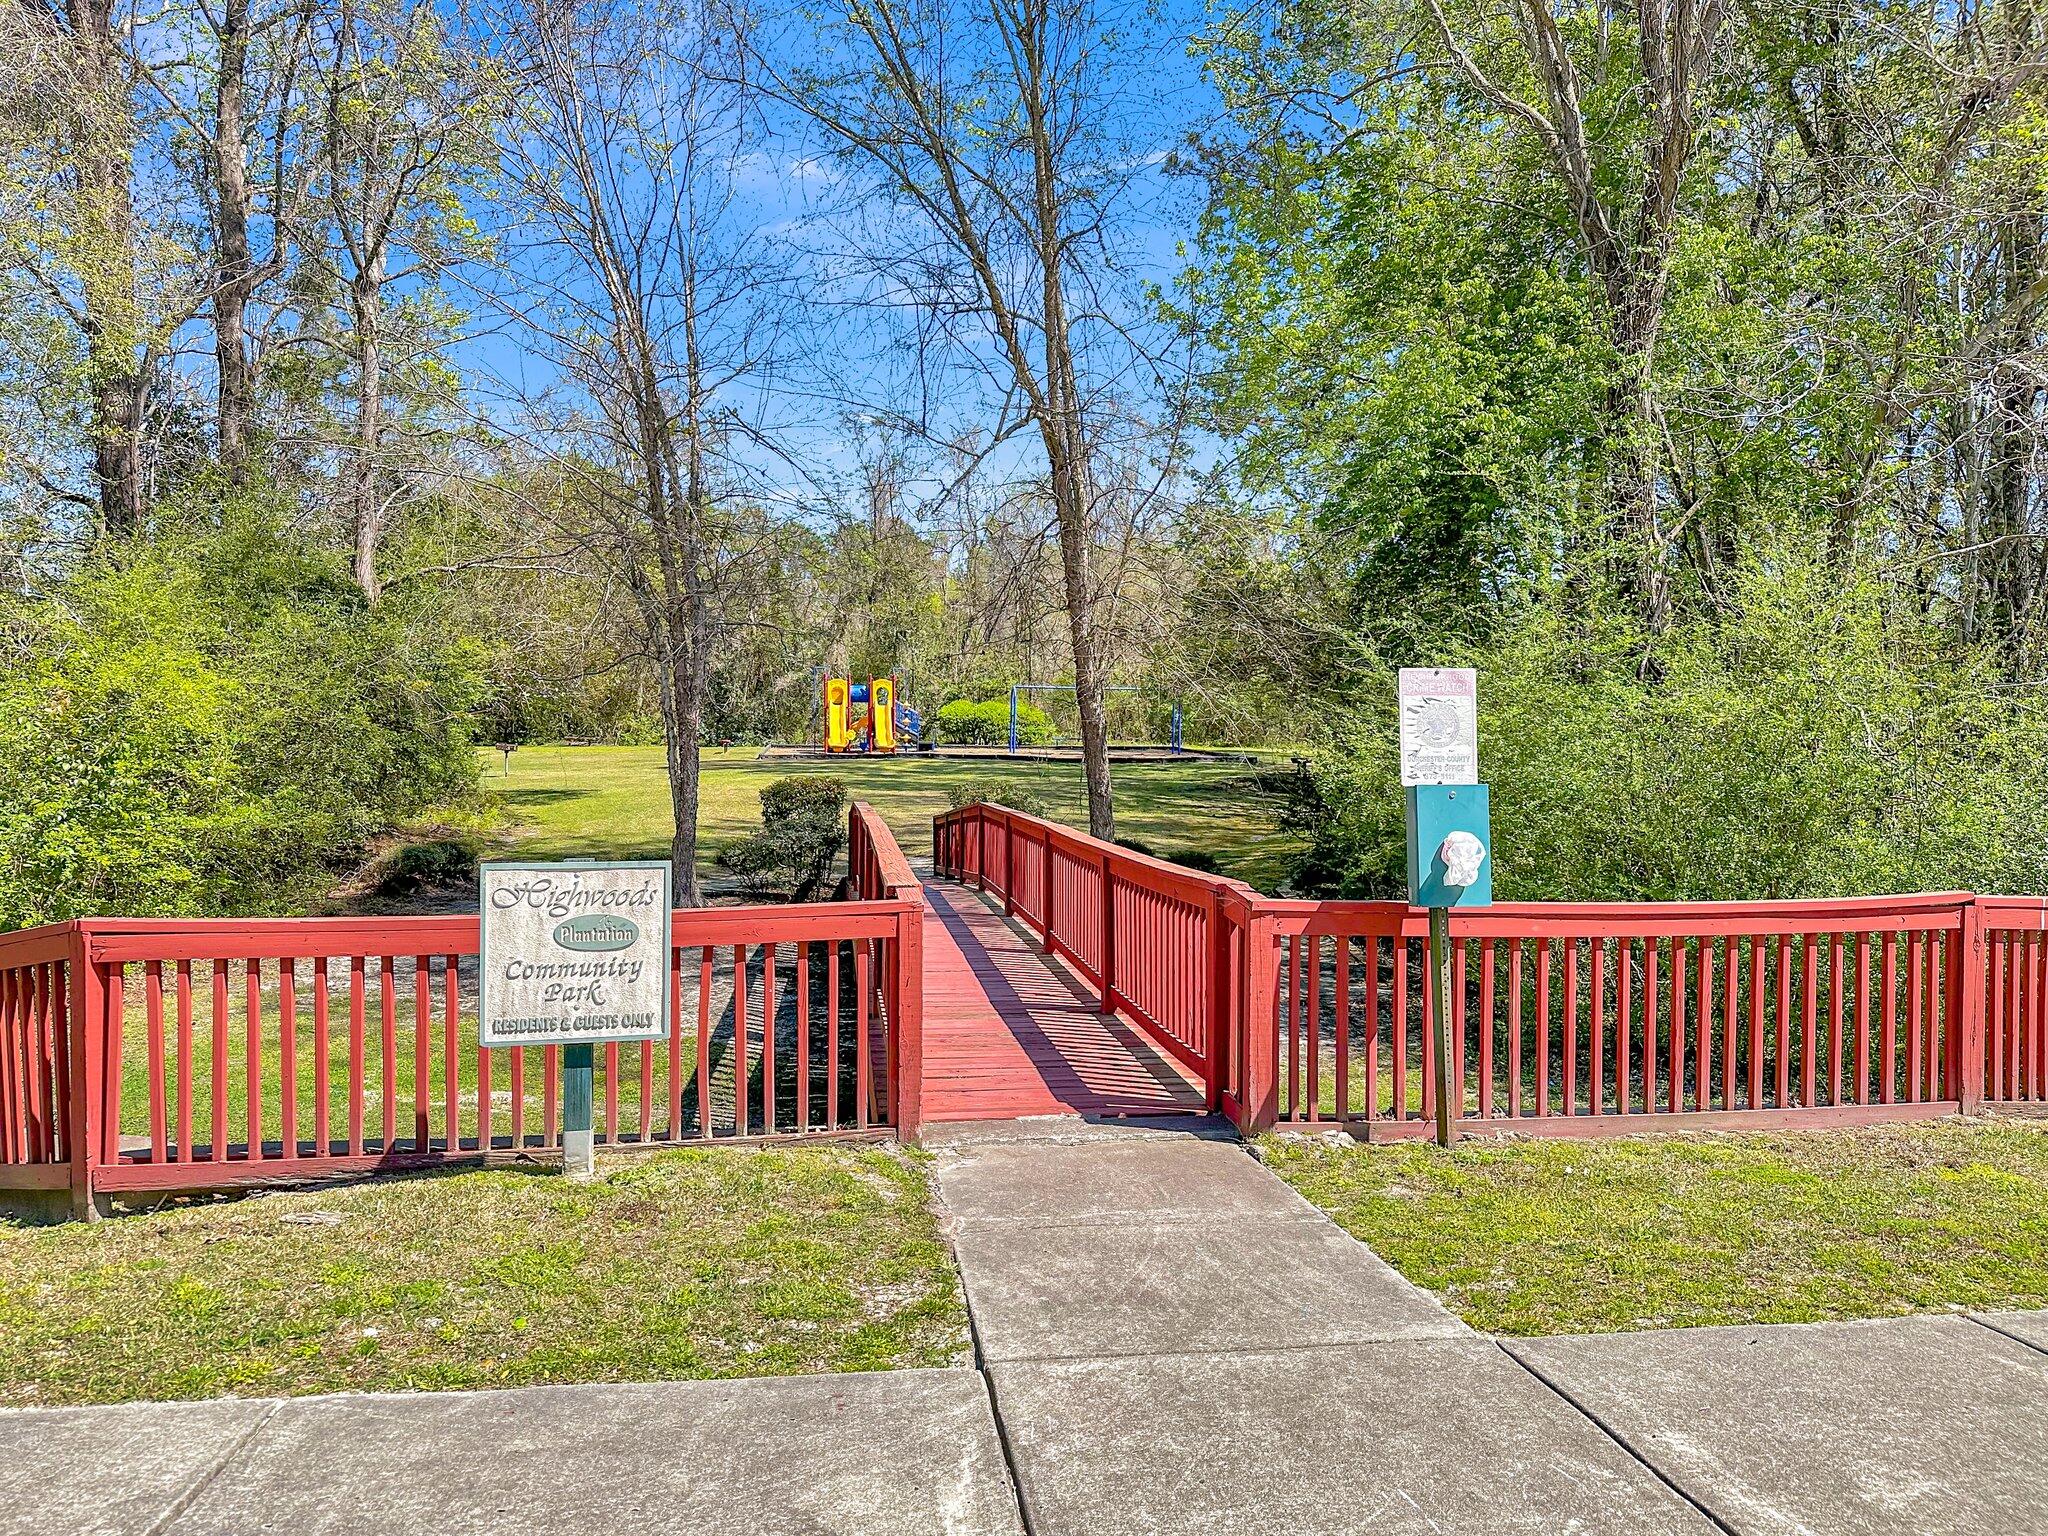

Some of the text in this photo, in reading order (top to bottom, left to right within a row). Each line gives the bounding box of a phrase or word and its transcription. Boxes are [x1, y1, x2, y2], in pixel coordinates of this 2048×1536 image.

[492, 878, 658, 917] Highwoods
[560, 925, 634, 944] Plantation
[505, 956, 644, 983] Community
[544, 979, 607, 1006] Park
[493, 1012, 655, 1035] RESIDENTS & GUESTS ONLY
